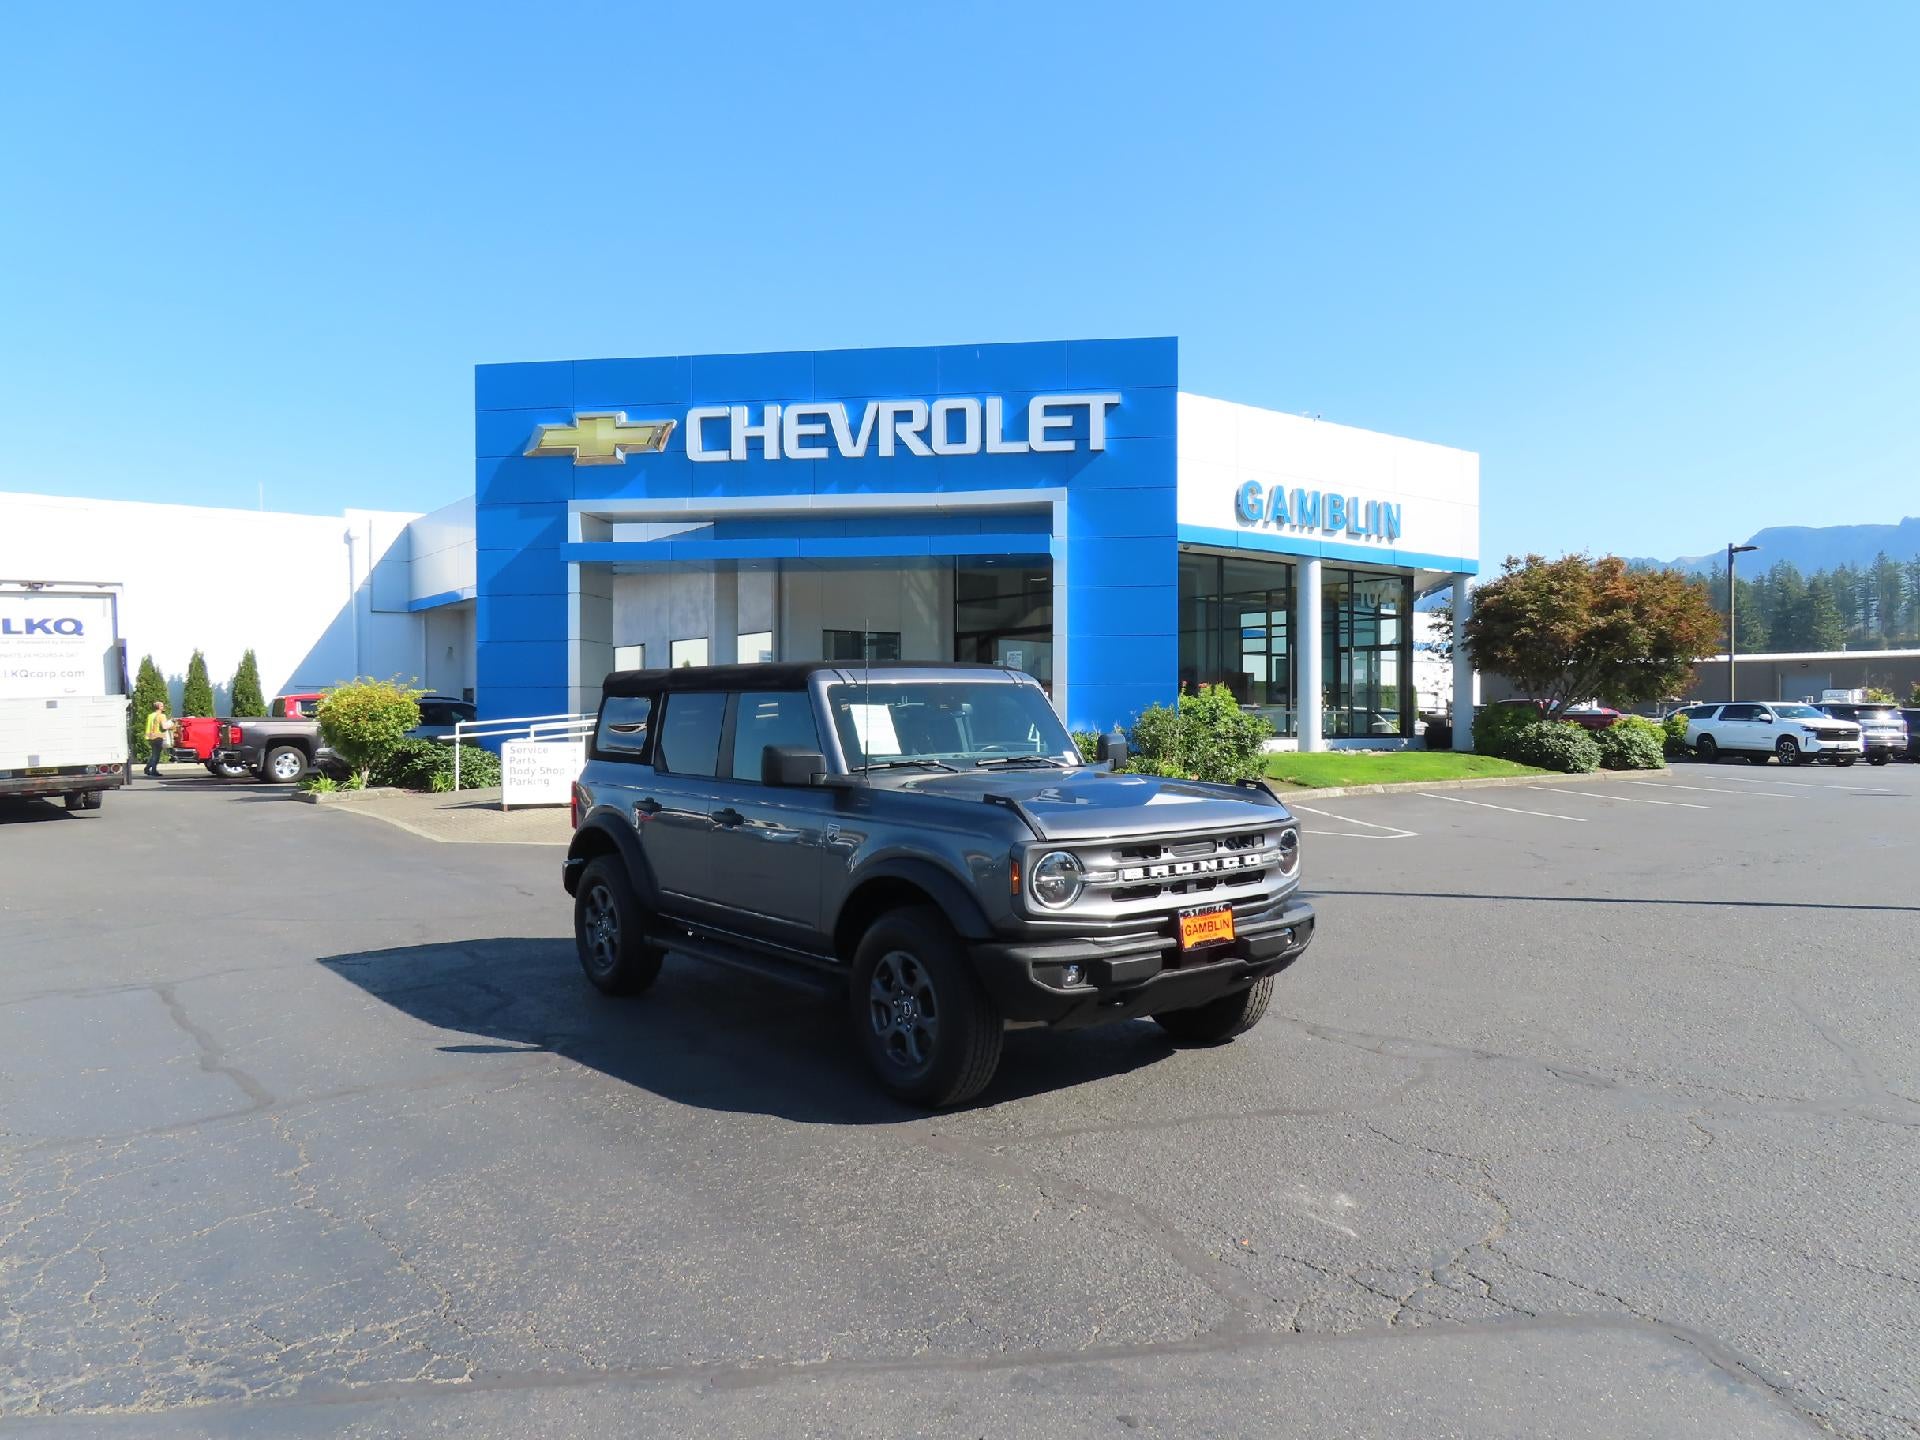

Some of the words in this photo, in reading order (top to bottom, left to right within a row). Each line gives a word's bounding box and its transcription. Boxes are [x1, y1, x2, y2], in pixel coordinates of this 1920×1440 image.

[685, 392, 1121, 463] CHEVROLET
[1234, 479, 1402, 540] GAMBLIN
[2, 618, 84, 636] LKQ
[510, 746, 549, 754] Service
[509, 756, 537, 765] Parts
[510, 767, 535, 777] Body
[1123, 853, 1261, 880] BRONCO
[1185, 919, 1231, 937] GAMBLIN
